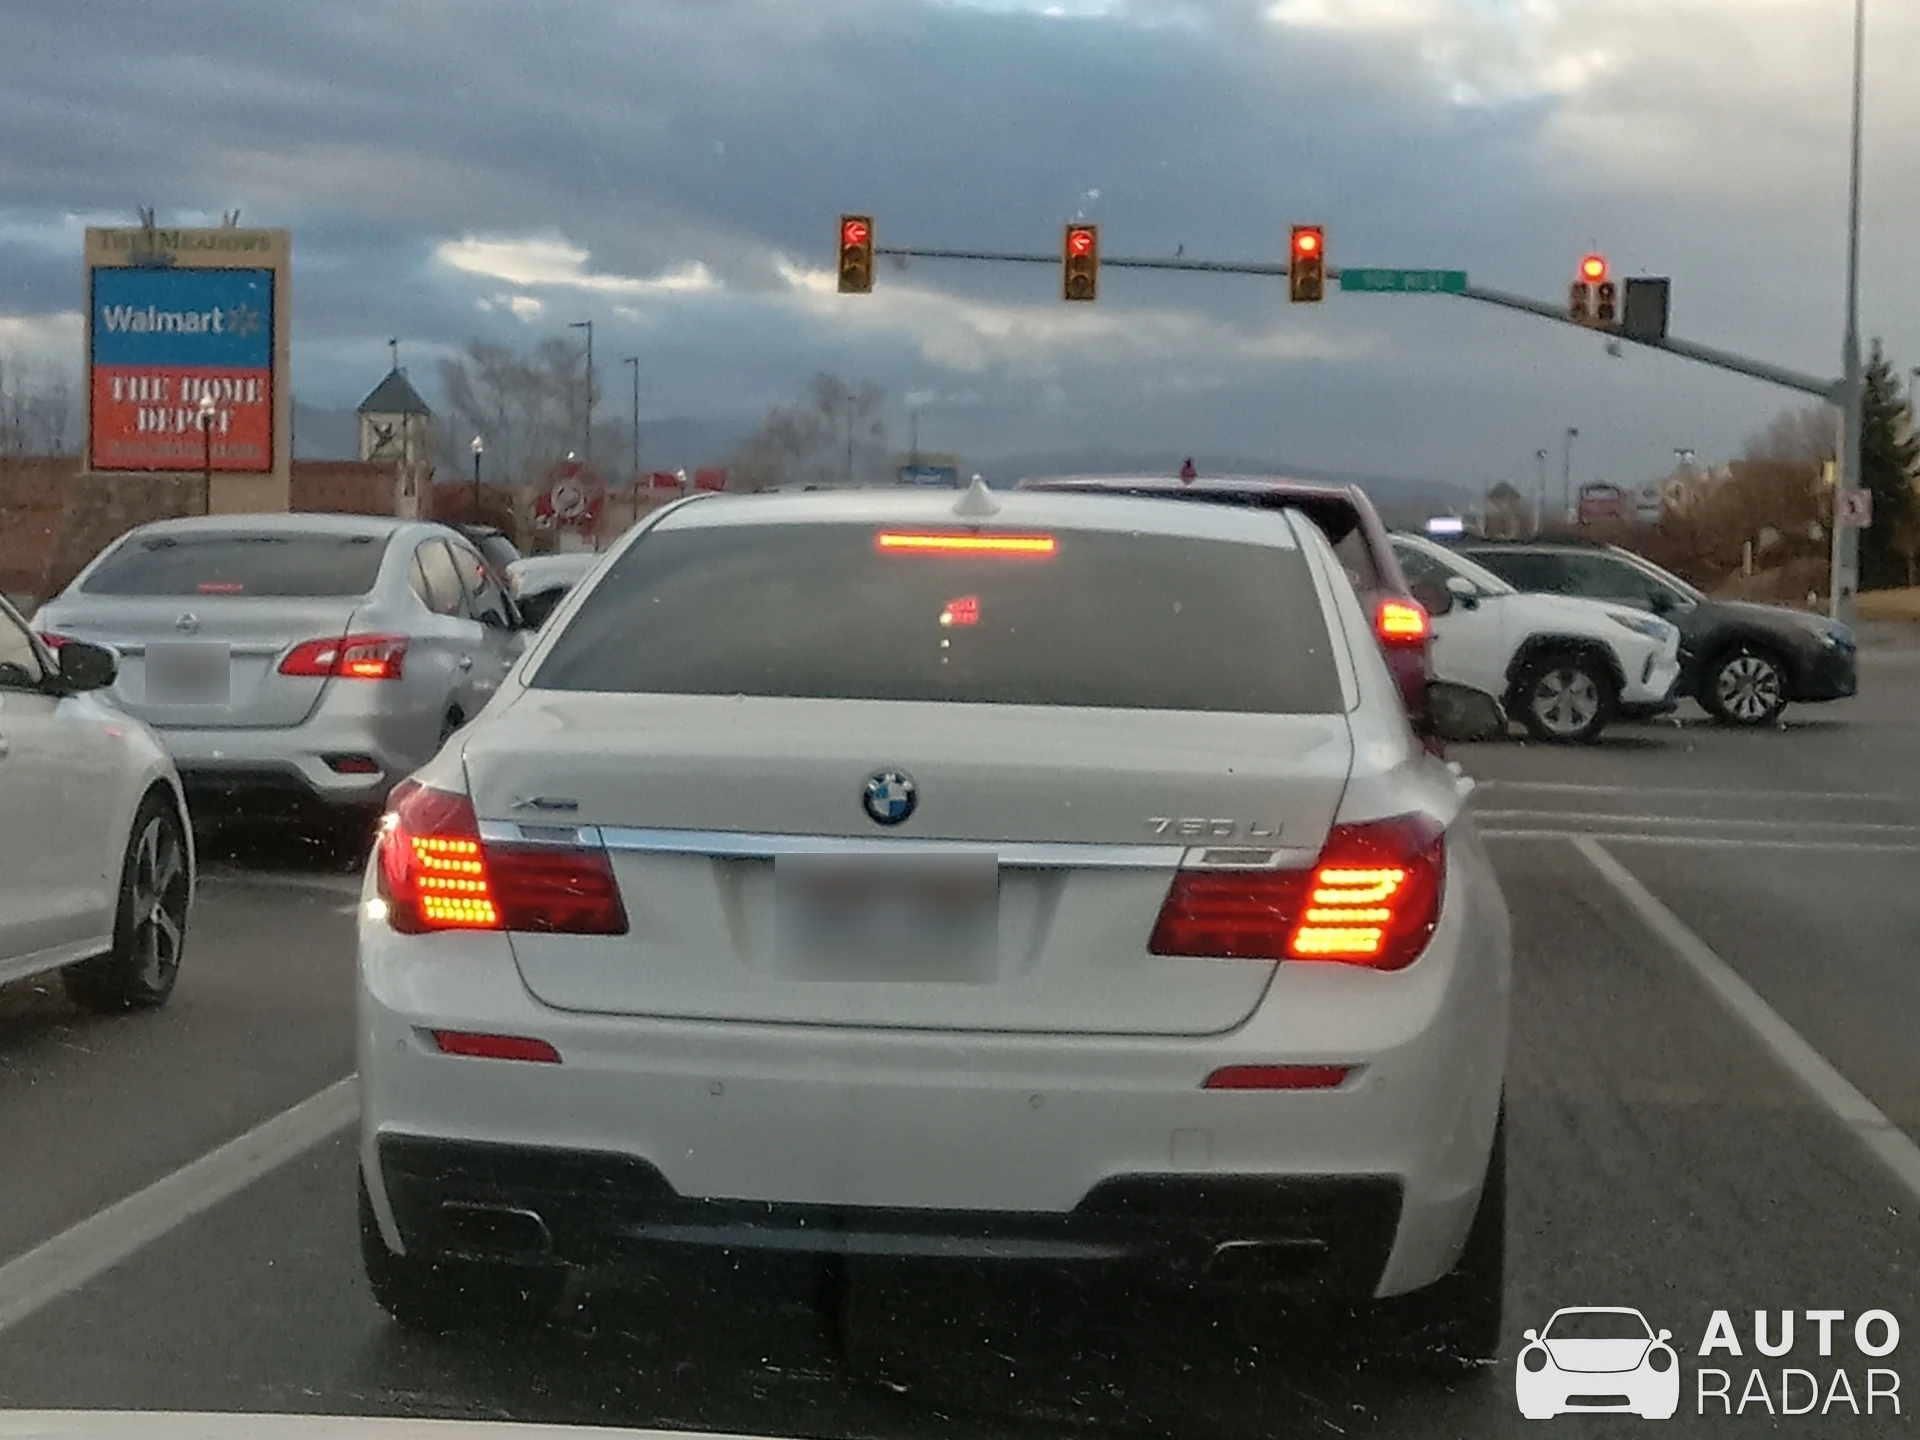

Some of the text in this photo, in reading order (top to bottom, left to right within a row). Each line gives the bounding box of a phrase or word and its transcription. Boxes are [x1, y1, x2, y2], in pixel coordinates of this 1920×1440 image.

[103, 304, 224, 334] Walmart
[107, 376, 265, 403] THE HOME
[136, 406, 236, 435] DEPOT
